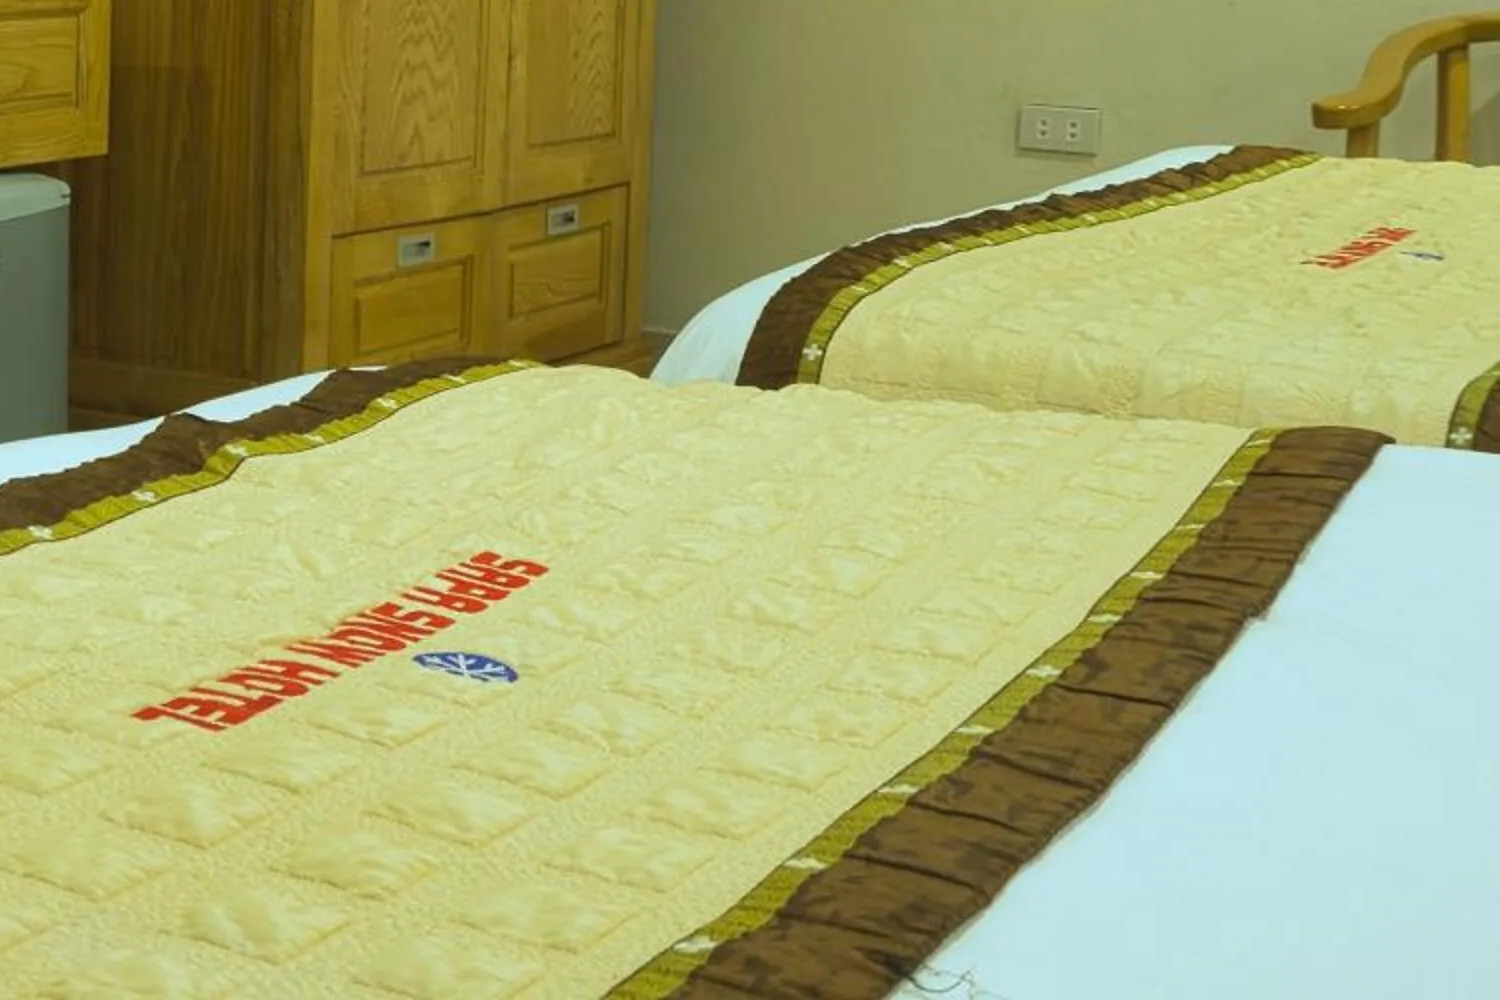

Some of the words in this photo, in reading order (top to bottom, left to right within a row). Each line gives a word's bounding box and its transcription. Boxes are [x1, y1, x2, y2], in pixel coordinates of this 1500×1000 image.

[400, 550, 550, 615] SAPA
[284, 601, 456, 669] SNOW
[130, 659, 341, 732] HOTEL
